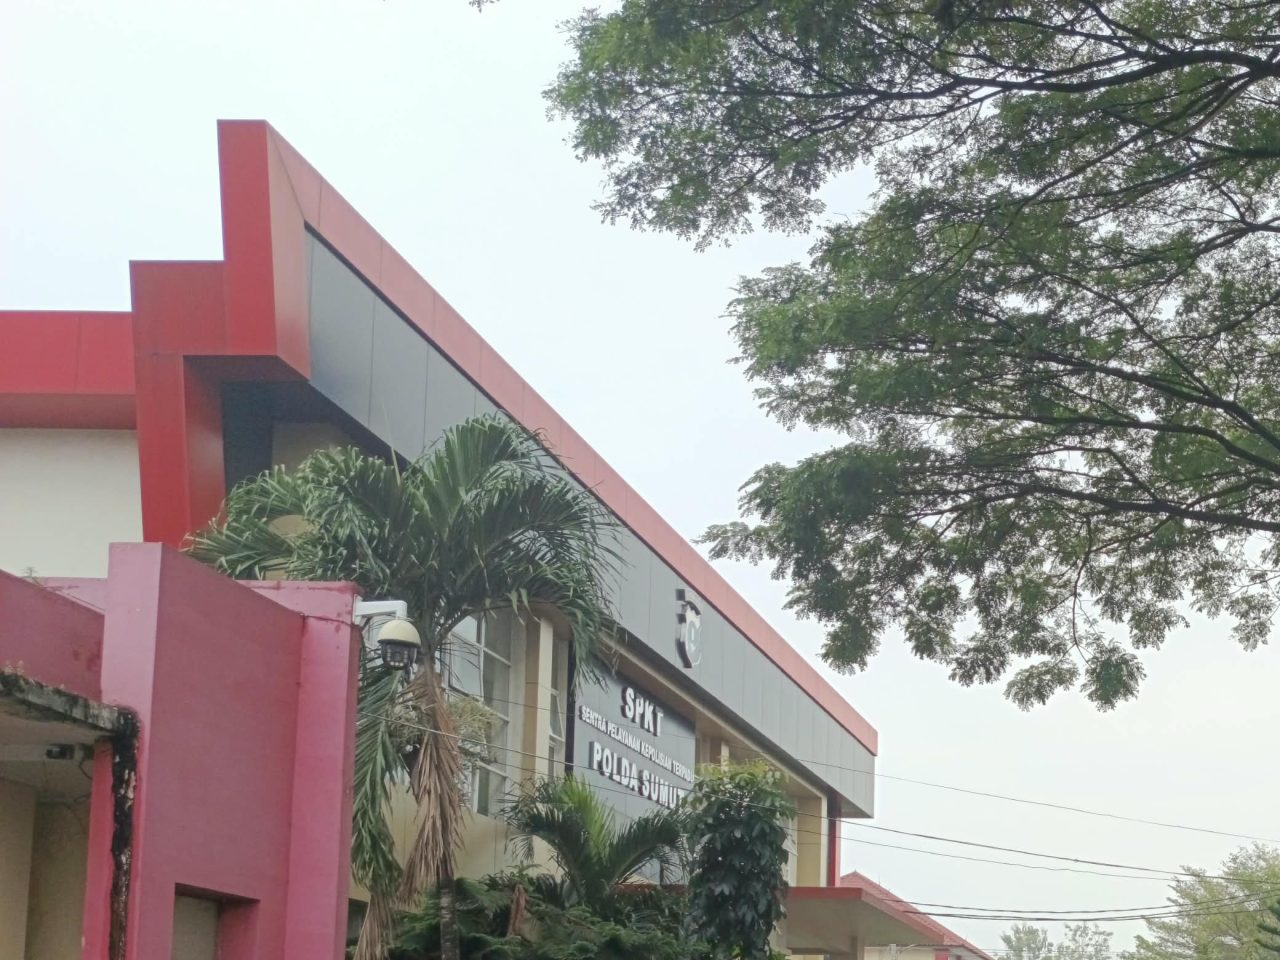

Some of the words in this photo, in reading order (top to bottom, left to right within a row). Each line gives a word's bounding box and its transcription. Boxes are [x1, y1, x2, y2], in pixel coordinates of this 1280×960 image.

[581, 705, 607, 733] SENTRA
[607, 722, 641, 752] PELAYANAN
[625, 686, 664, 736] SPKT
[593, 741, 638, 792] POLDA
